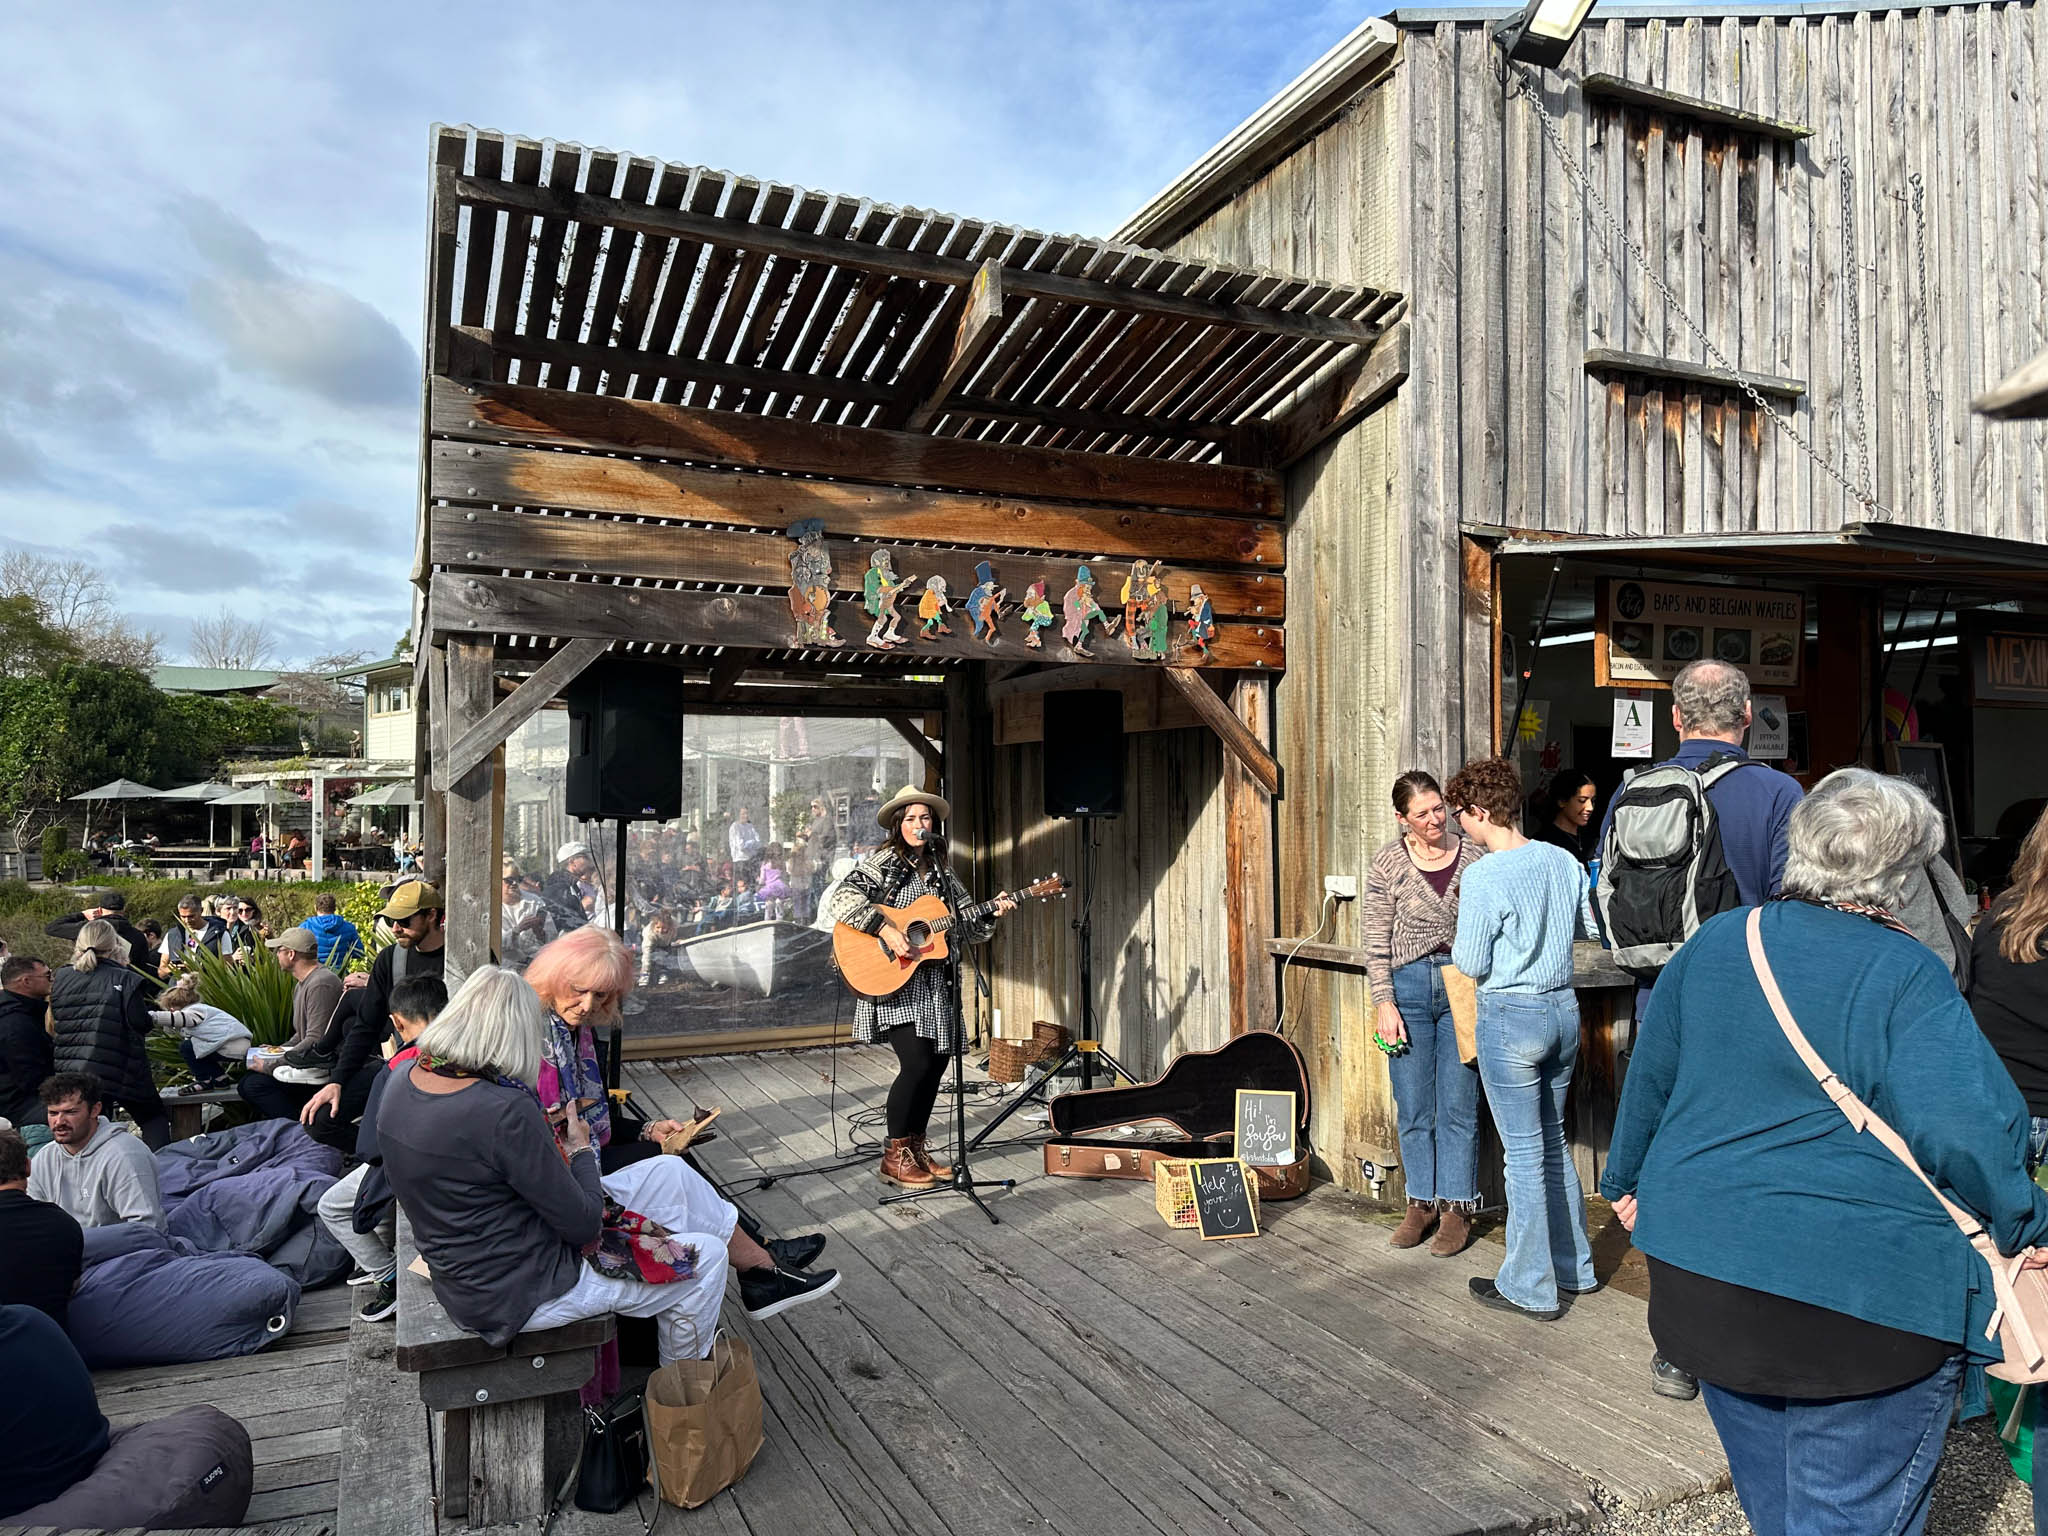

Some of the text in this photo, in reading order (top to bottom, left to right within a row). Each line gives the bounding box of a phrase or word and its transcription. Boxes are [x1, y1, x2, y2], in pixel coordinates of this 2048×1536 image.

[1653, 592, 1681, 612] BAPS
[1685, 594, 1706, 613] AND
[1709, 597, 1752, 616] BELGIAN
[1755, 599, 1798, 620] WAFFLES
[1623, 700, 1642, 727] A
[1753, 743, 1785, 751] AVAILABLE
[1244, 1098, 1262, 1122] Hi!
[1200, 1175, 1226, 1196] Help
